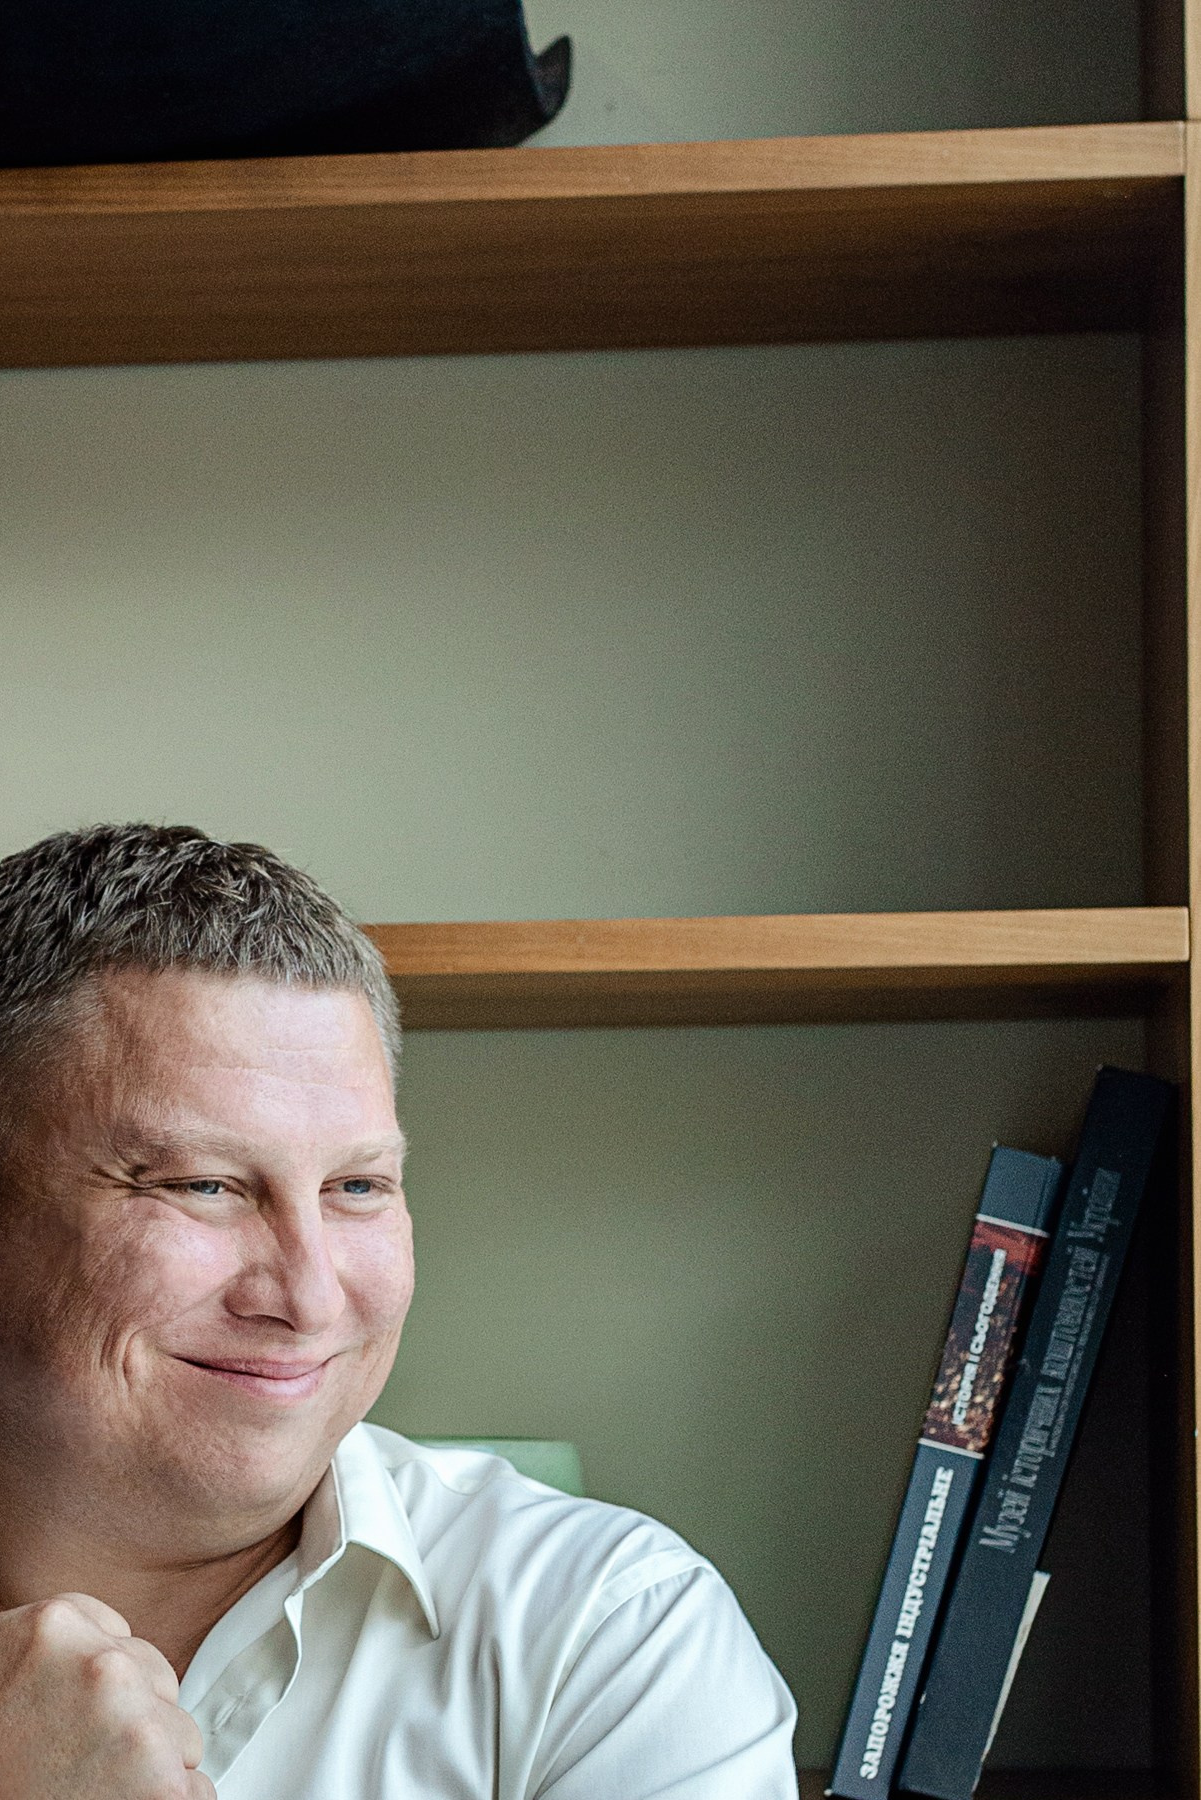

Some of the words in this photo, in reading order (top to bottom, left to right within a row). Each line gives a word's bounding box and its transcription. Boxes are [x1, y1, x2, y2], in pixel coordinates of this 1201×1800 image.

[952, 1363, 978, 1428] ІСТОРІЯ
[860, 1640, 909, 1779] ЗАПОРОЖЖЯ
[895, 1467, 954, 1638] ІНДУСТРІАЛЬНЕ
